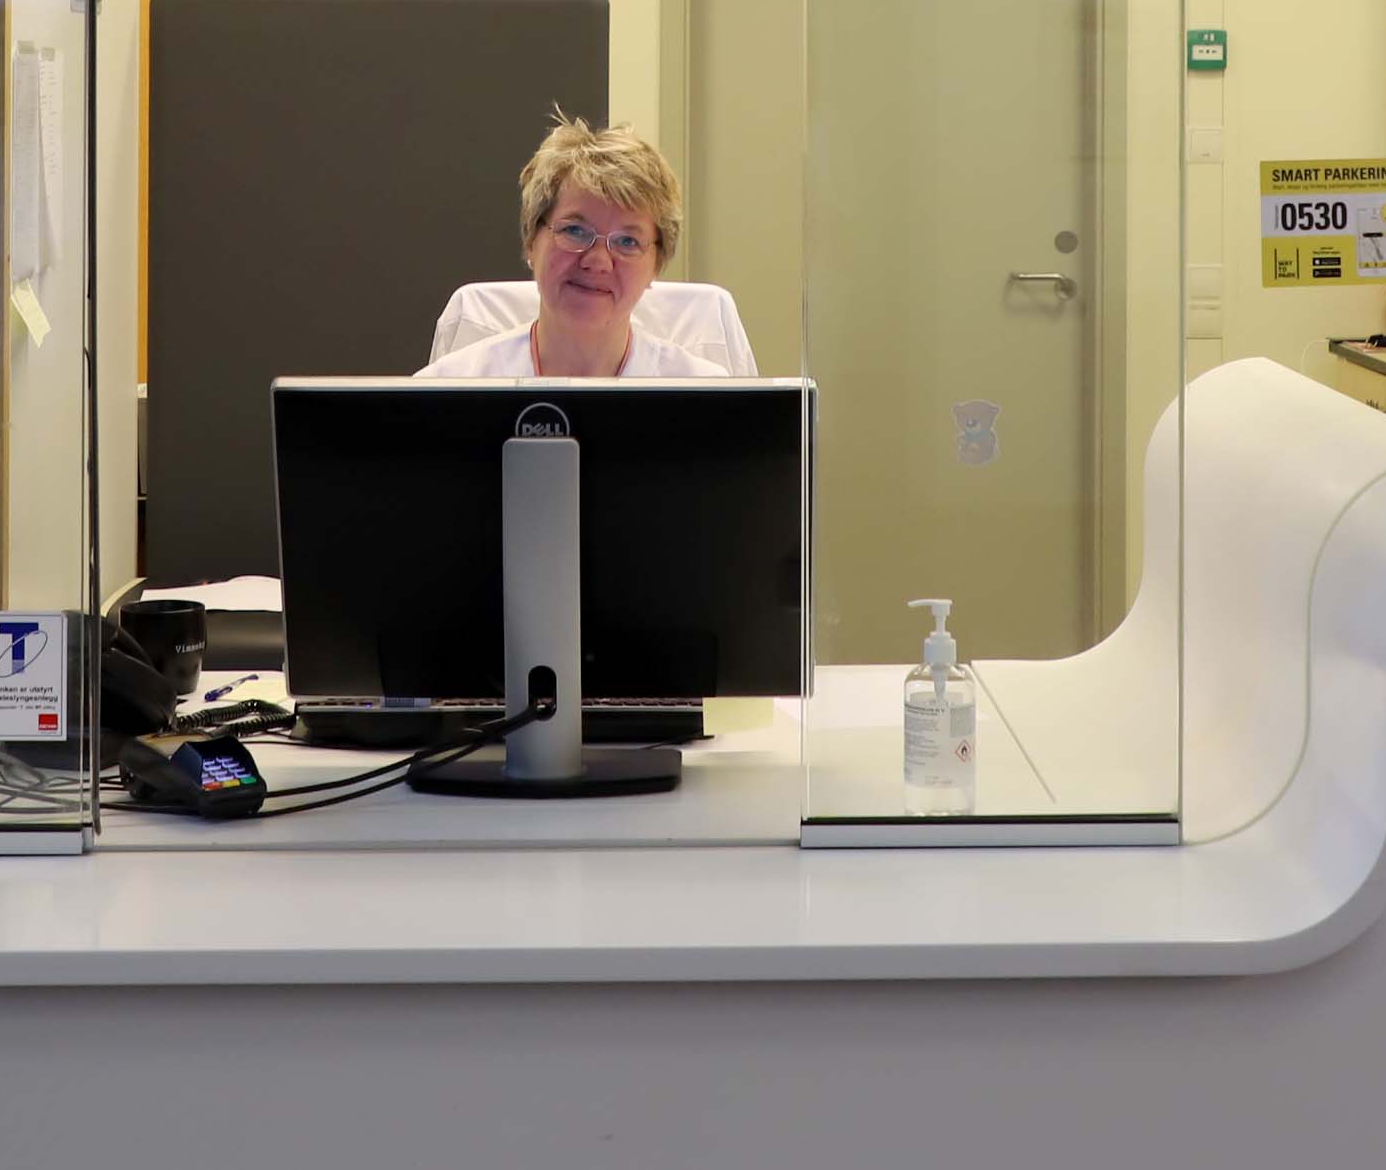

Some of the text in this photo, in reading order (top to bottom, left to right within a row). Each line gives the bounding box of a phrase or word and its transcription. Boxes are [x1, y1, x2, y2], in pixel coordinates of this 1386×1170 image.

[1272, 168, 1321, 183] SMART
[1280, 201, 1348, 231] 0530
[522, 422, 564, 436] DELL
[29, 685, 54, 694] utstyrt
